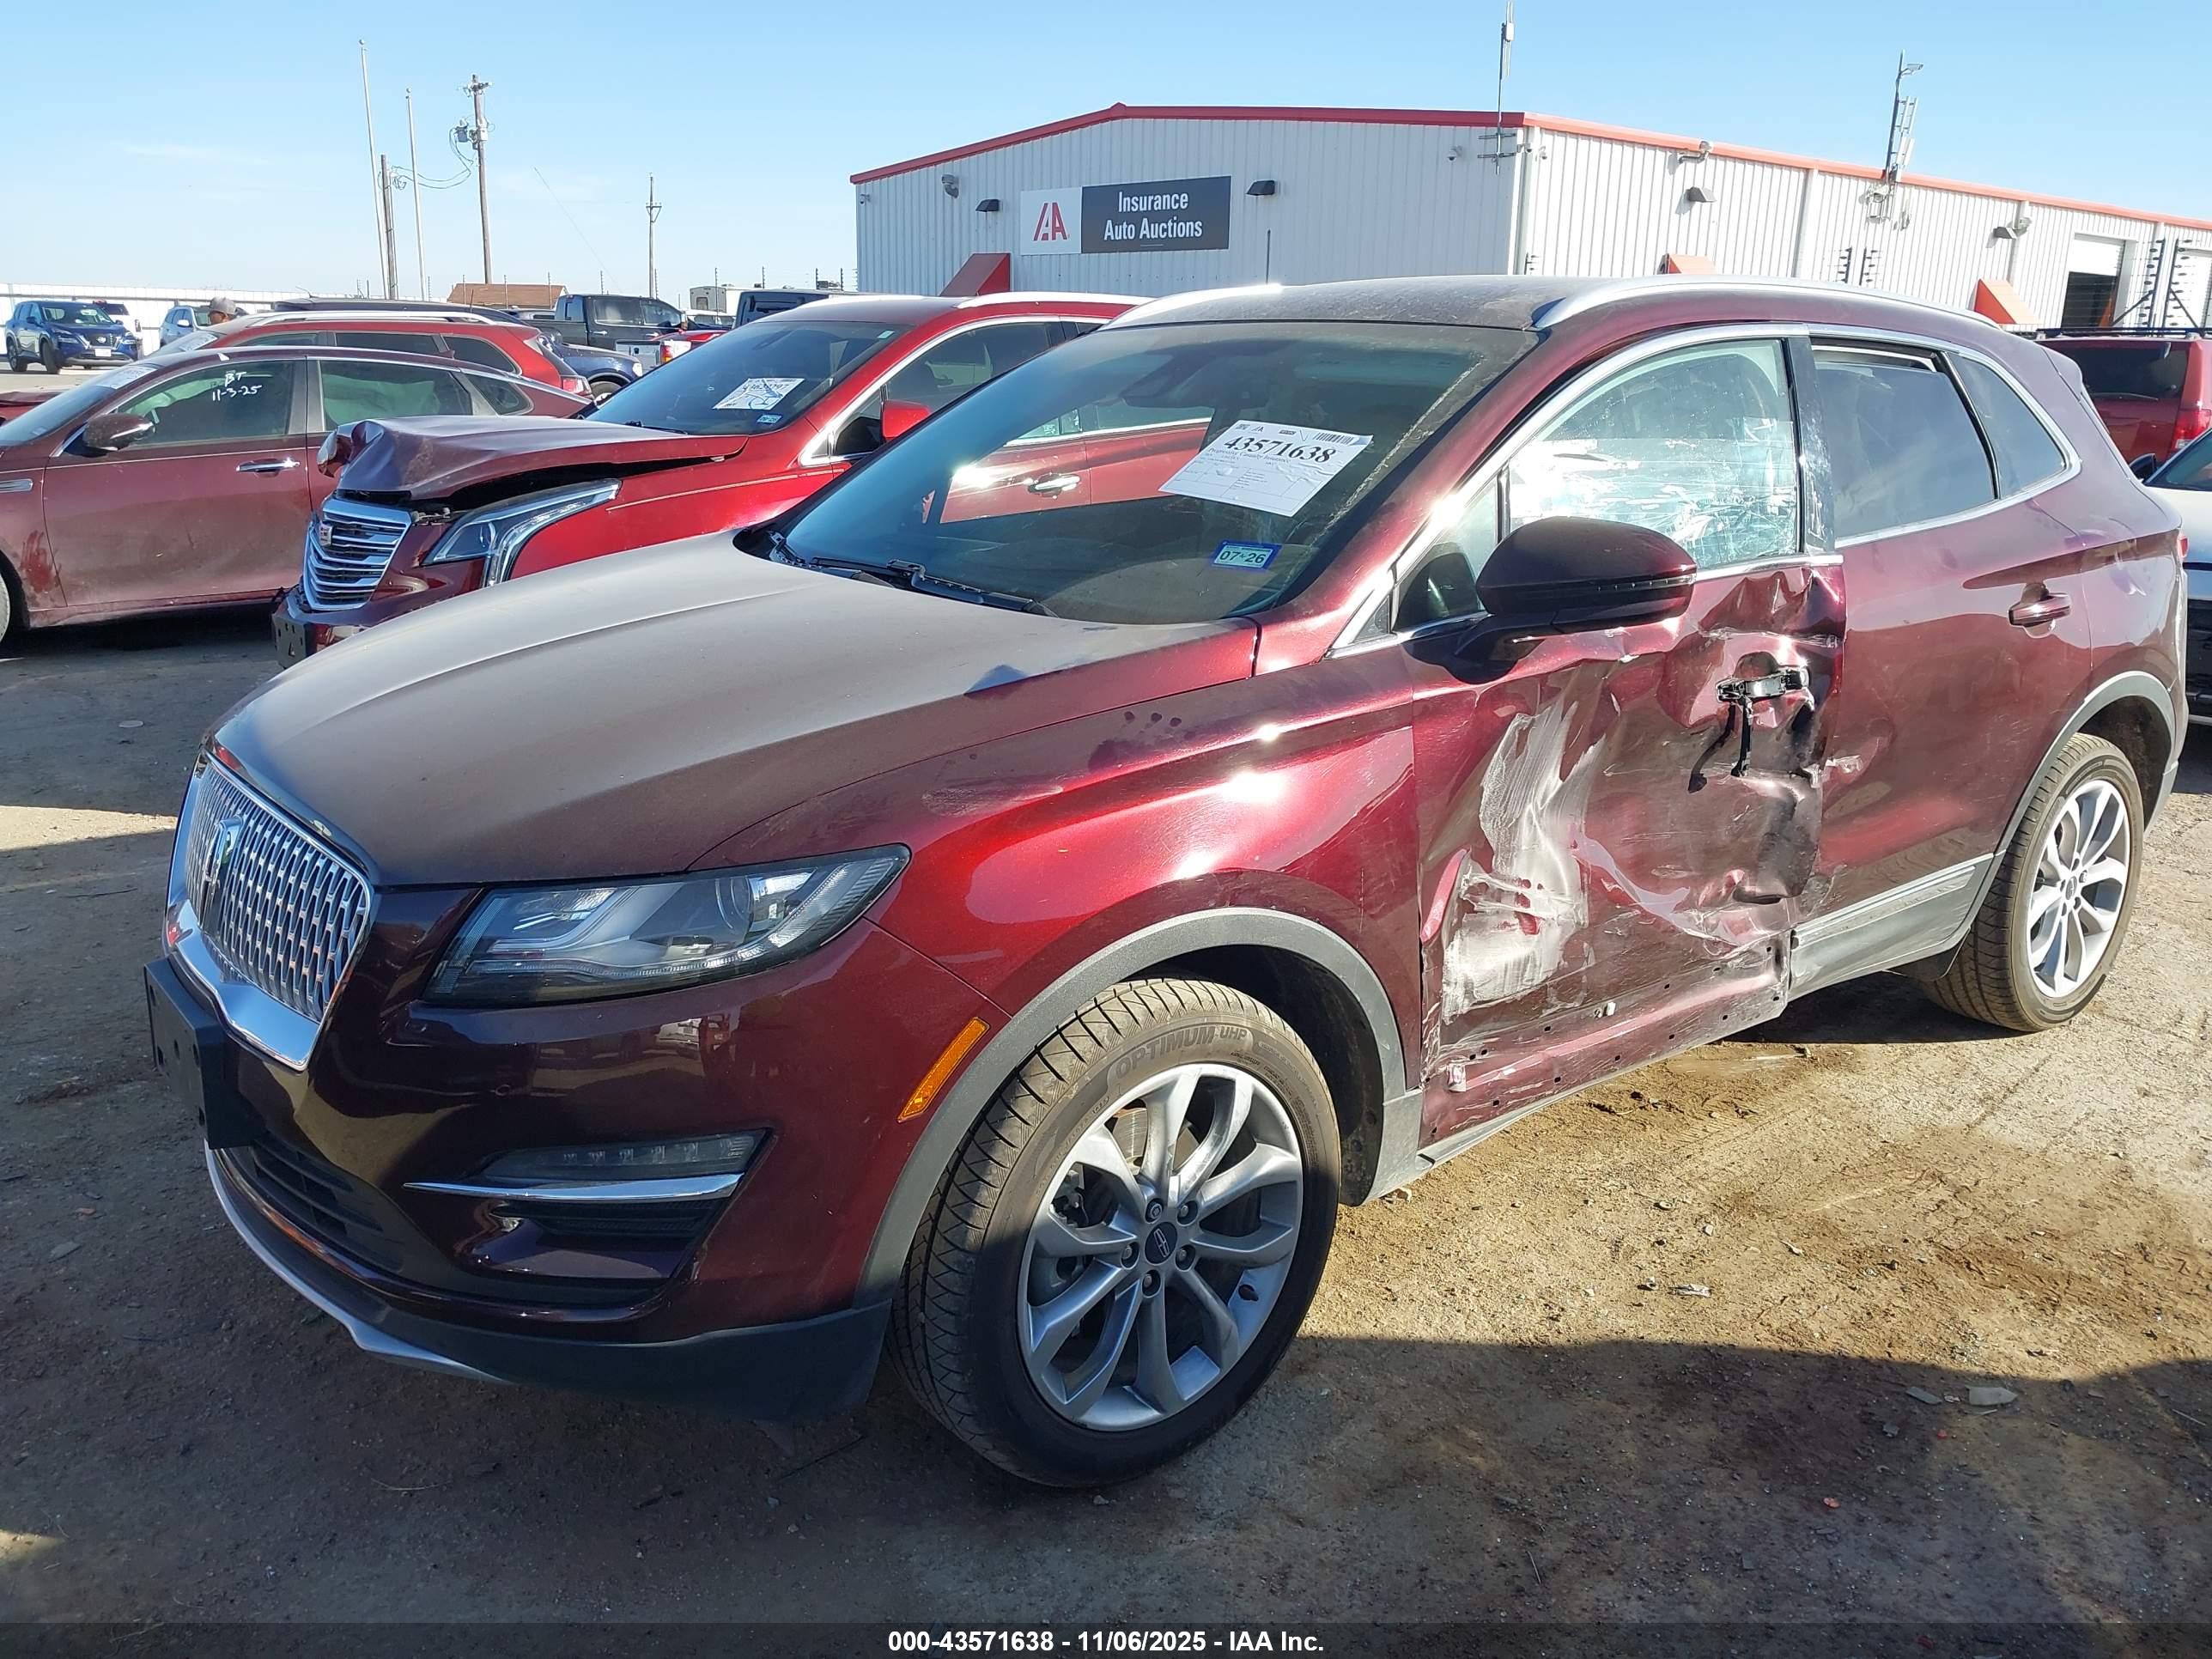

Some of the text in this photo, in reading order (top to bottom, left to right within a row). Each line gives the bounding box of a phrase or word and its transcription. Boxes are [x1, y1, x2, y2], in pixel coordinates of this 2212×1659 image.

[1118, 191, 1188, 213] Insurance
[1103, 216, 1203, 241] Auto Auctions
[212, 385, 262, 401] 11-3-25
[1224, 435, 1336, 463] 43571638
[1116, 1026, 1215, 1079] OPTIMUM
